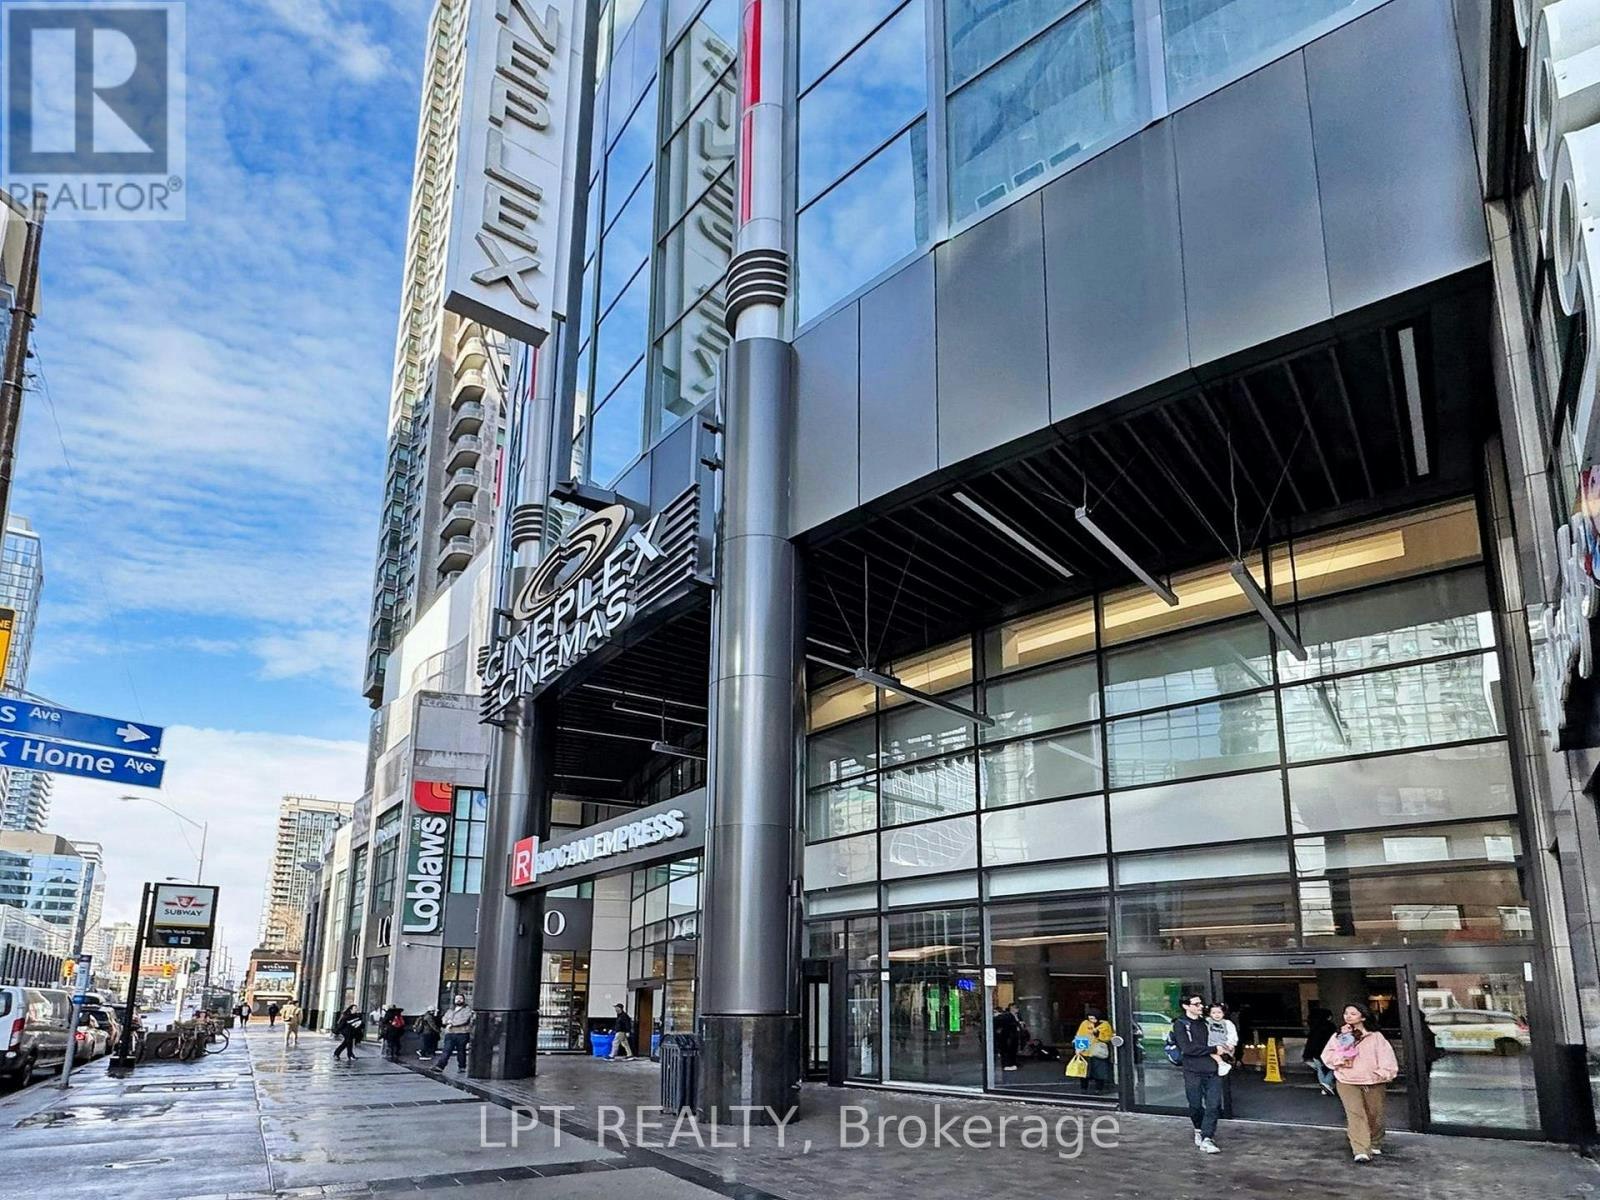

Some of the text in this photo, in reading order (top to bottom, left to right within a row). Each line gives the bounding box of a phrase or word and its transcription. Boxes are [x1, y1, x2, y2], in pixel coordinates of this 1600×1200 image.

[484, 512, 667, 687] CINEPLEX
[499, 588, 636, 706] CINEMAS
[29, 707, 61, 722] Ave
[21, 740, 115, 774] Home
[124, 757, 156, 774] Ave
[594, 809, 685, 857] EMPRESS
[403, 816, 447, 933] Loblaws
[164, 909, 202, 917] SUBWAY
[544, 909, 566, 937] O
